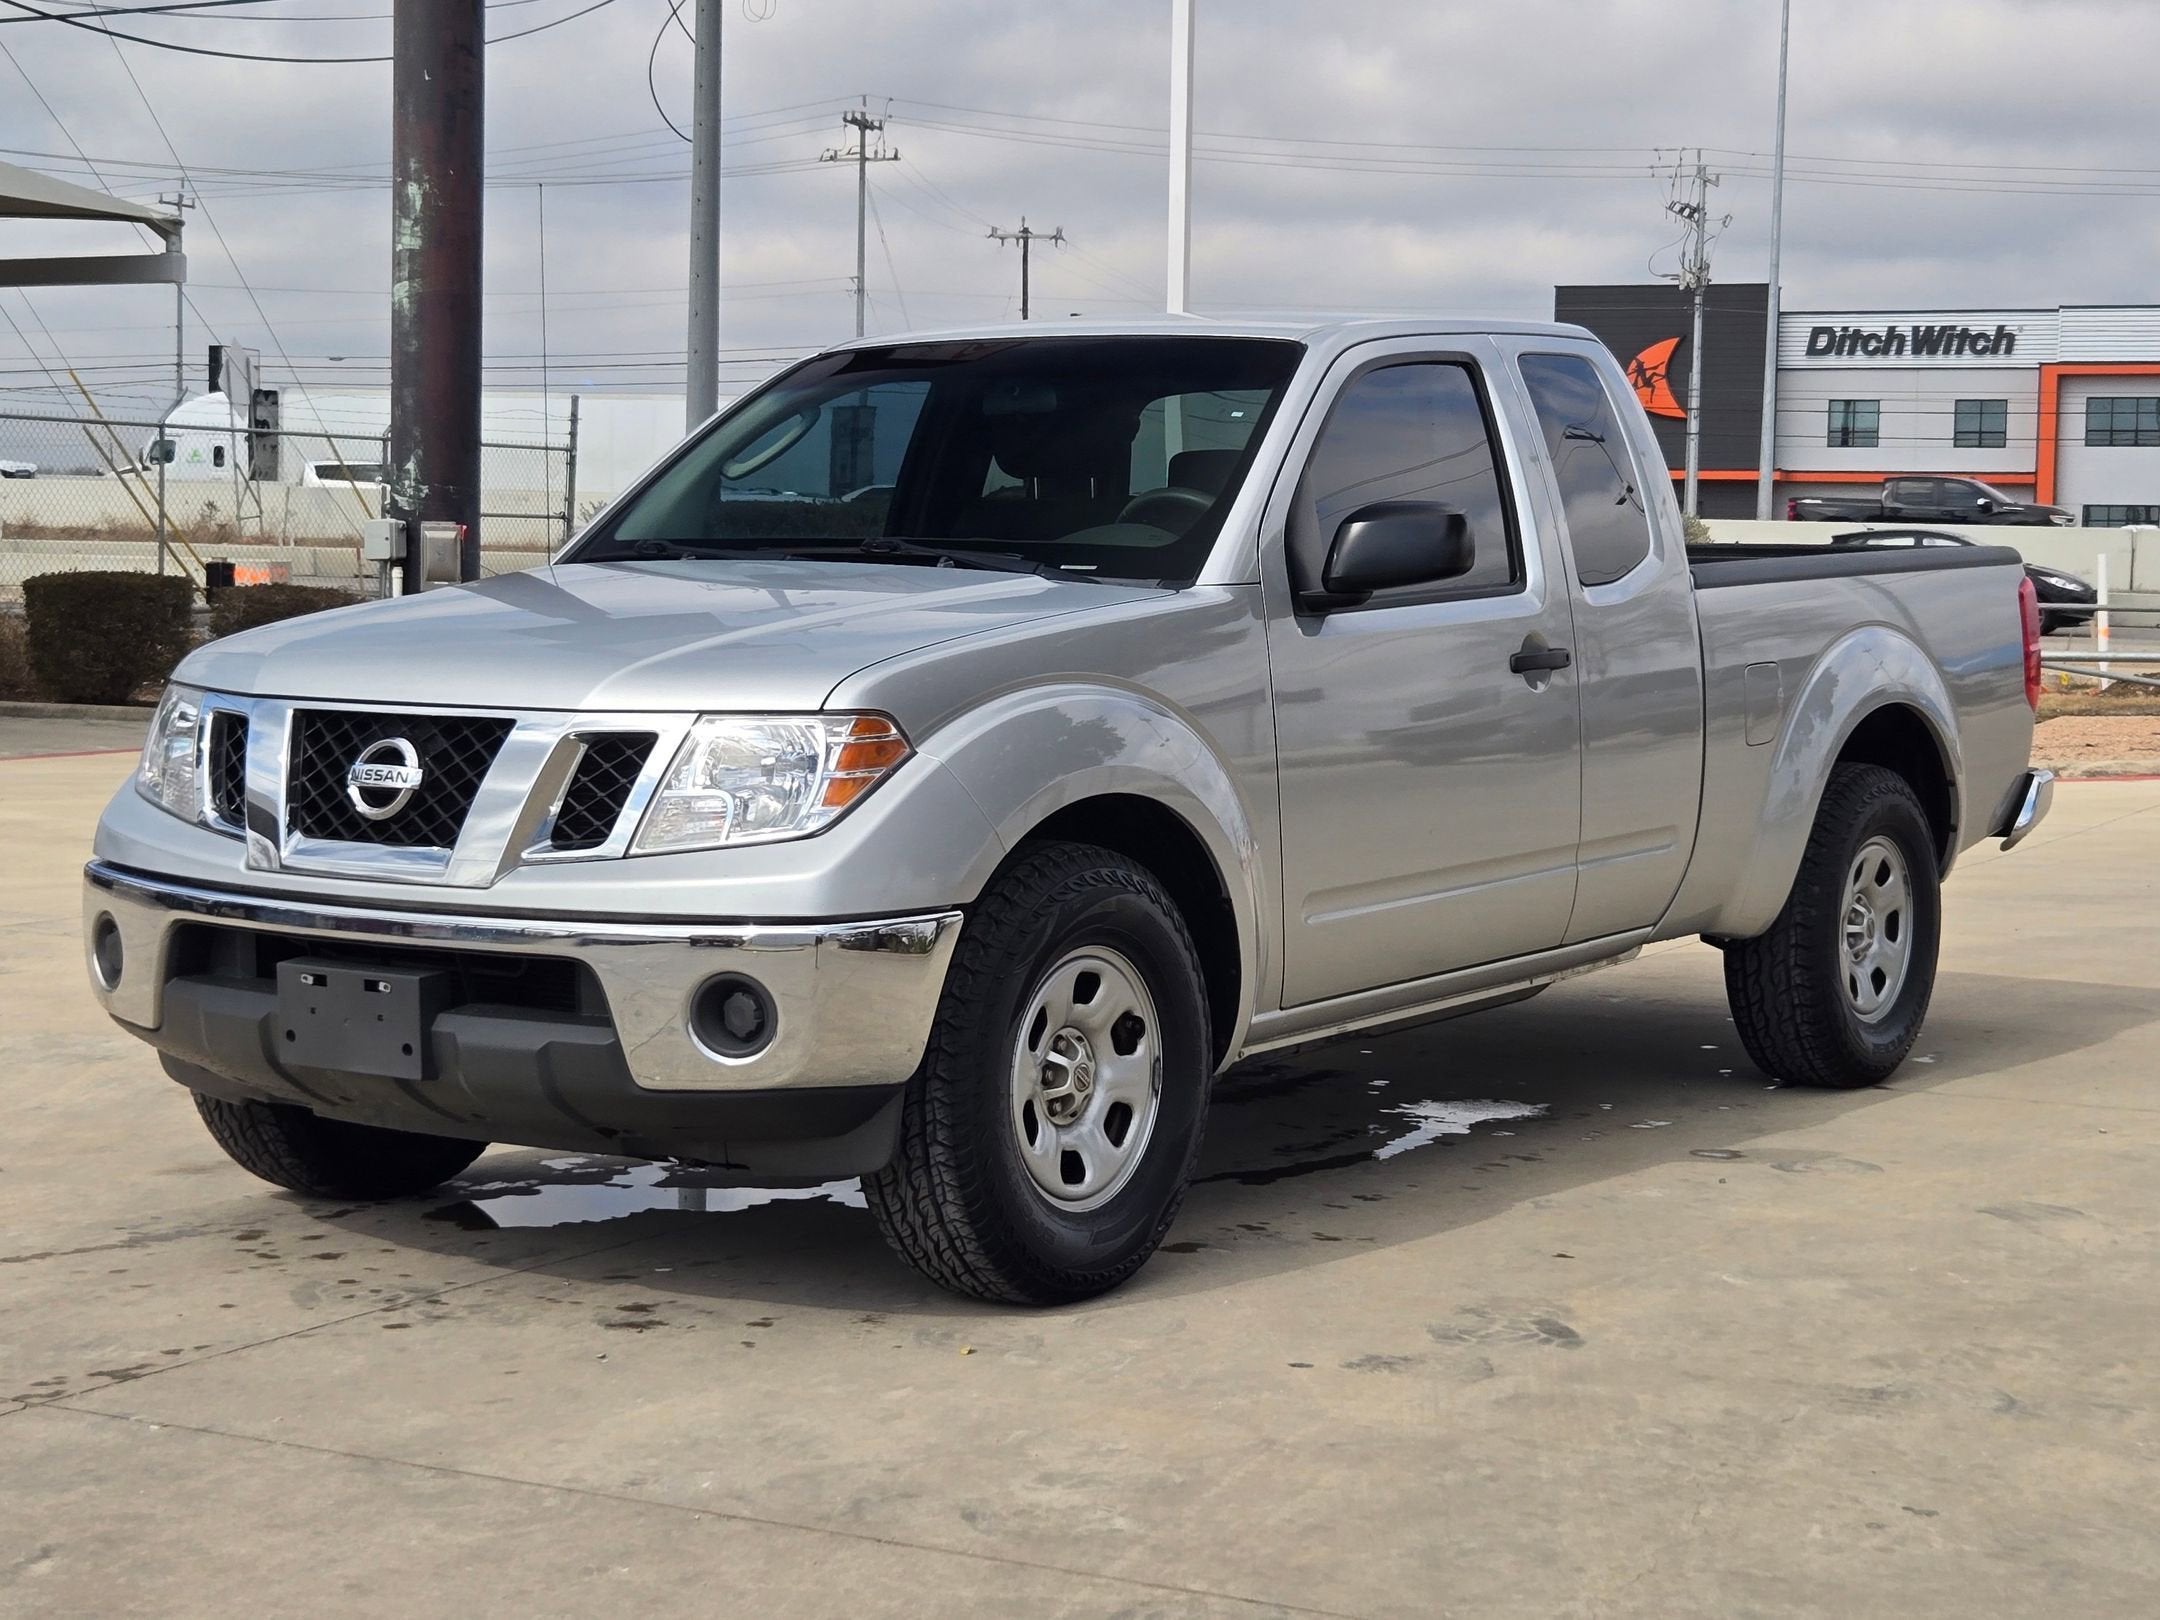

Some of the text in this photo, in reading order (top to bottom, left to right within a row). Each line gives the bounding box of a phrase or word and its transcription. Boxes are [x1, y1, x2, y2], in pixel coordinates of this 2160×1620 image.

[1805, 325, 2015, 356] Ditch Witch
[350, 768, 409, 784] NISSAN
